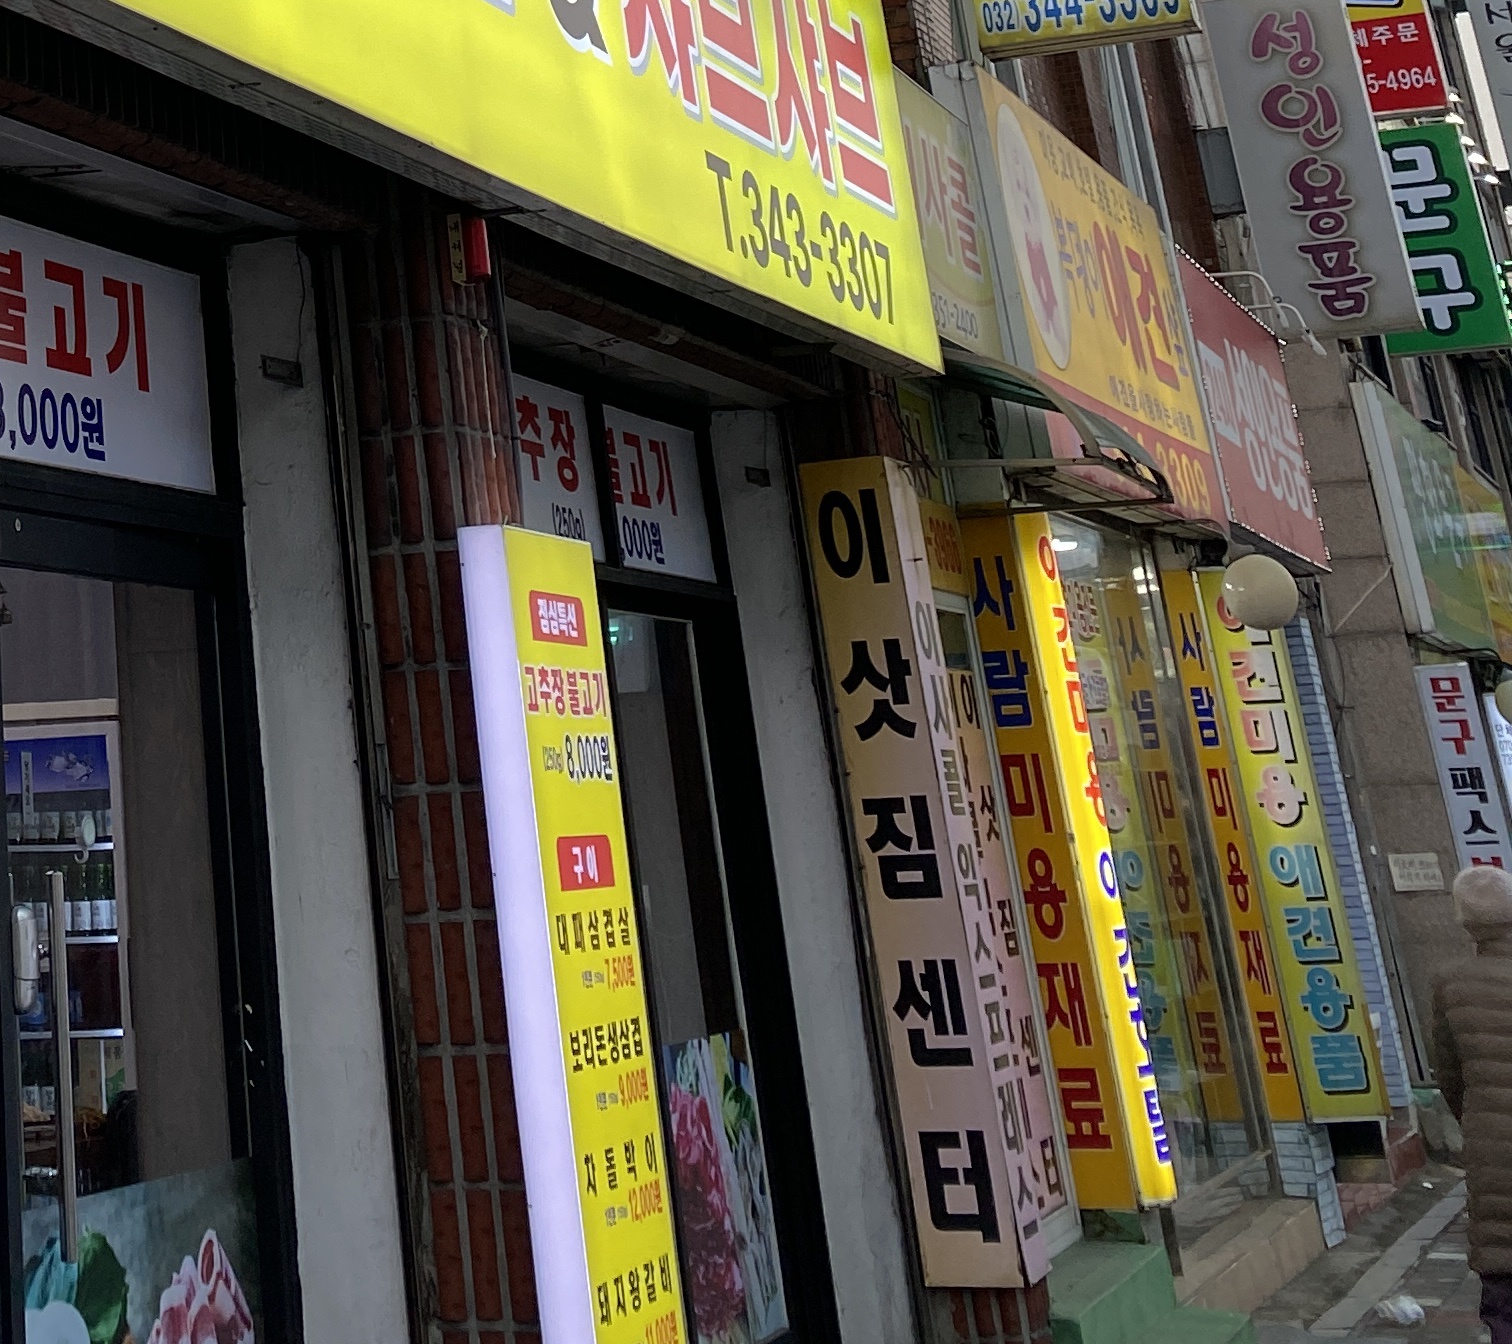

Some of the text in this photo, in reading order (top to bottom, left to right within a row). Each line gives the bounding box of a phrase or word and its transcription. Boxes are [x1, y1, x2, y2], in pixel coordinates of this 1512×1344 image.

[1251, 10, 1375, 320] 성인용품
[704, 151, 896, 327] T.343-3307
[524, 665, 607, 718] 고추장 불고기
[1429, 676, 1476, 757] 문구
[564, 734, 614, 785] 8,000원
[1447, 765, 1501, 847] 팩스
[571, 844, 600, 884] 구이
[818, 487, 1002, 1245] 이삿짐센터
[973, 554, 1113, 1152] 사람미용재료
